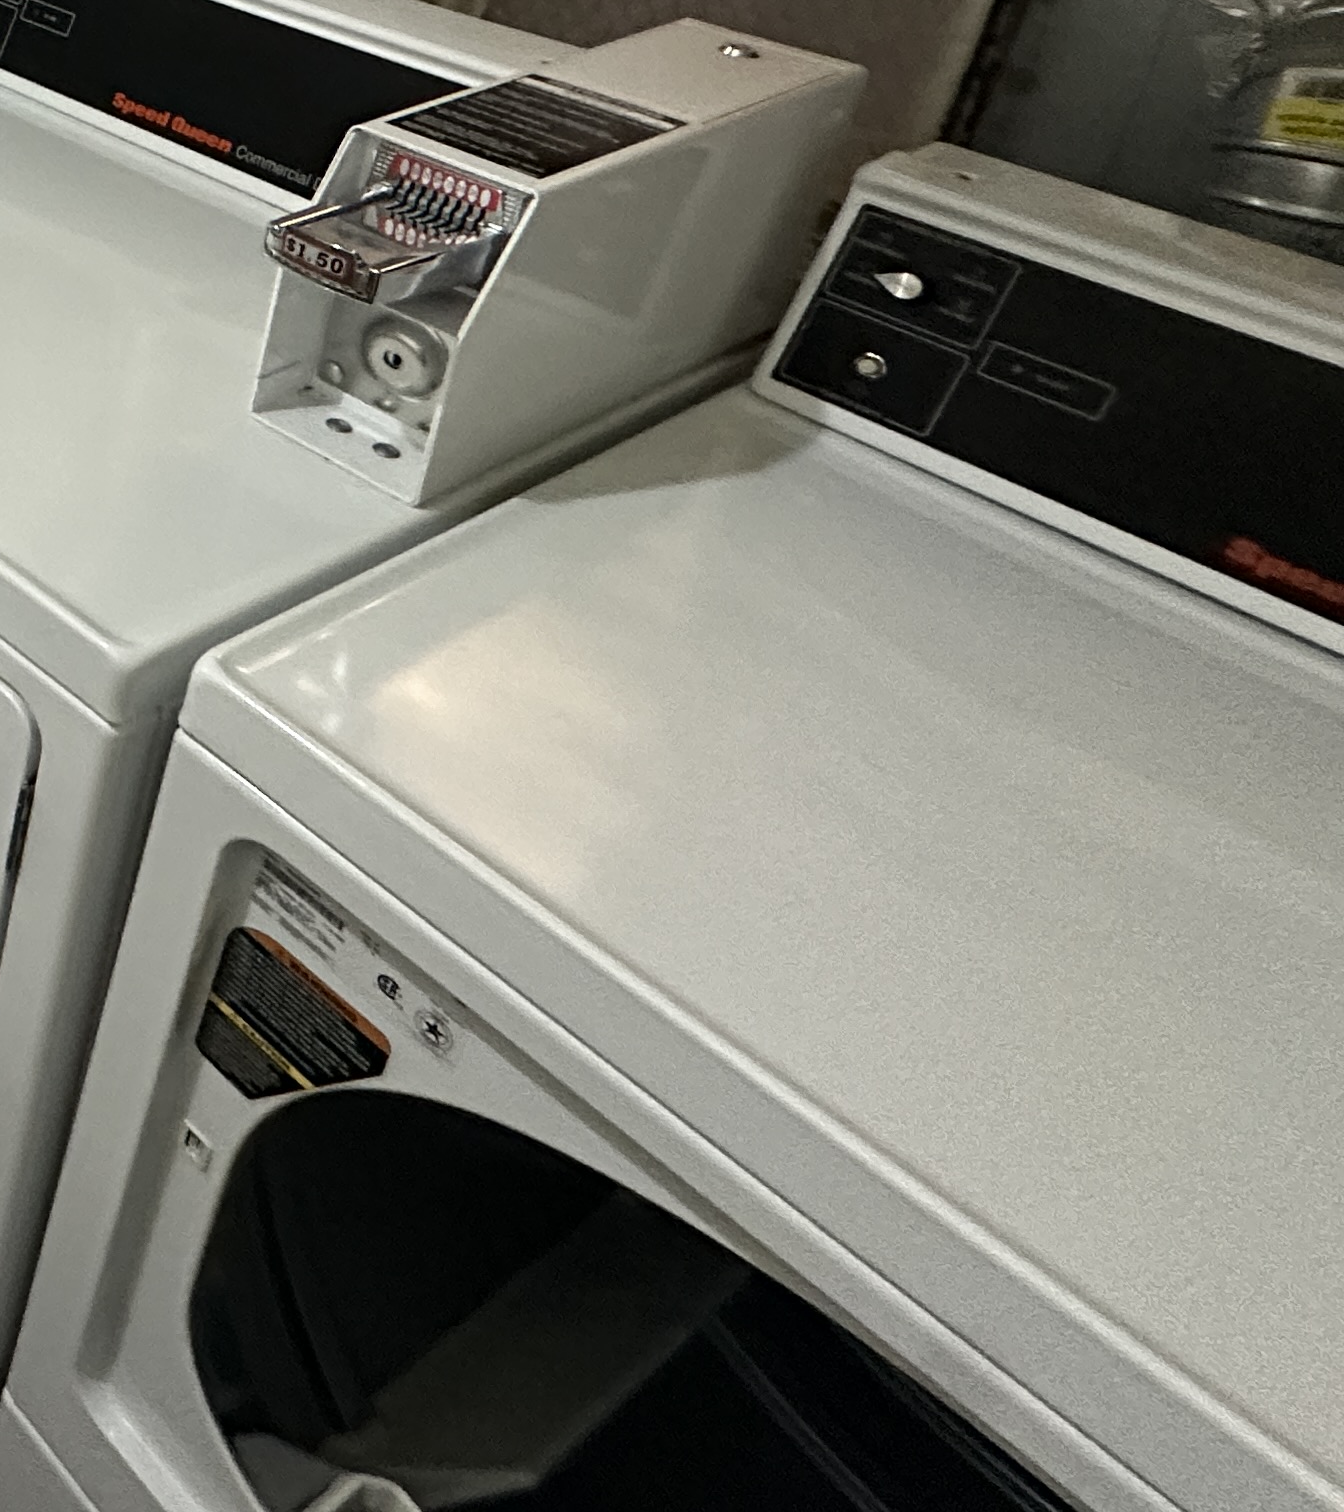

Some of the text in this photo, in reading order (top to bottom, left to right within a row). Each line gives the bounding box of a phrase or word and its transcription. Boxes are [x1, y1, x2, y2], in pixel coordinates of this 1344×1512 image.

[113, 92, 171, 127] Speed
[171, 116, 232, 153] Queen
[235, 145, 312, 187] Commercial
[286, 238, 344, 274] $1.50
